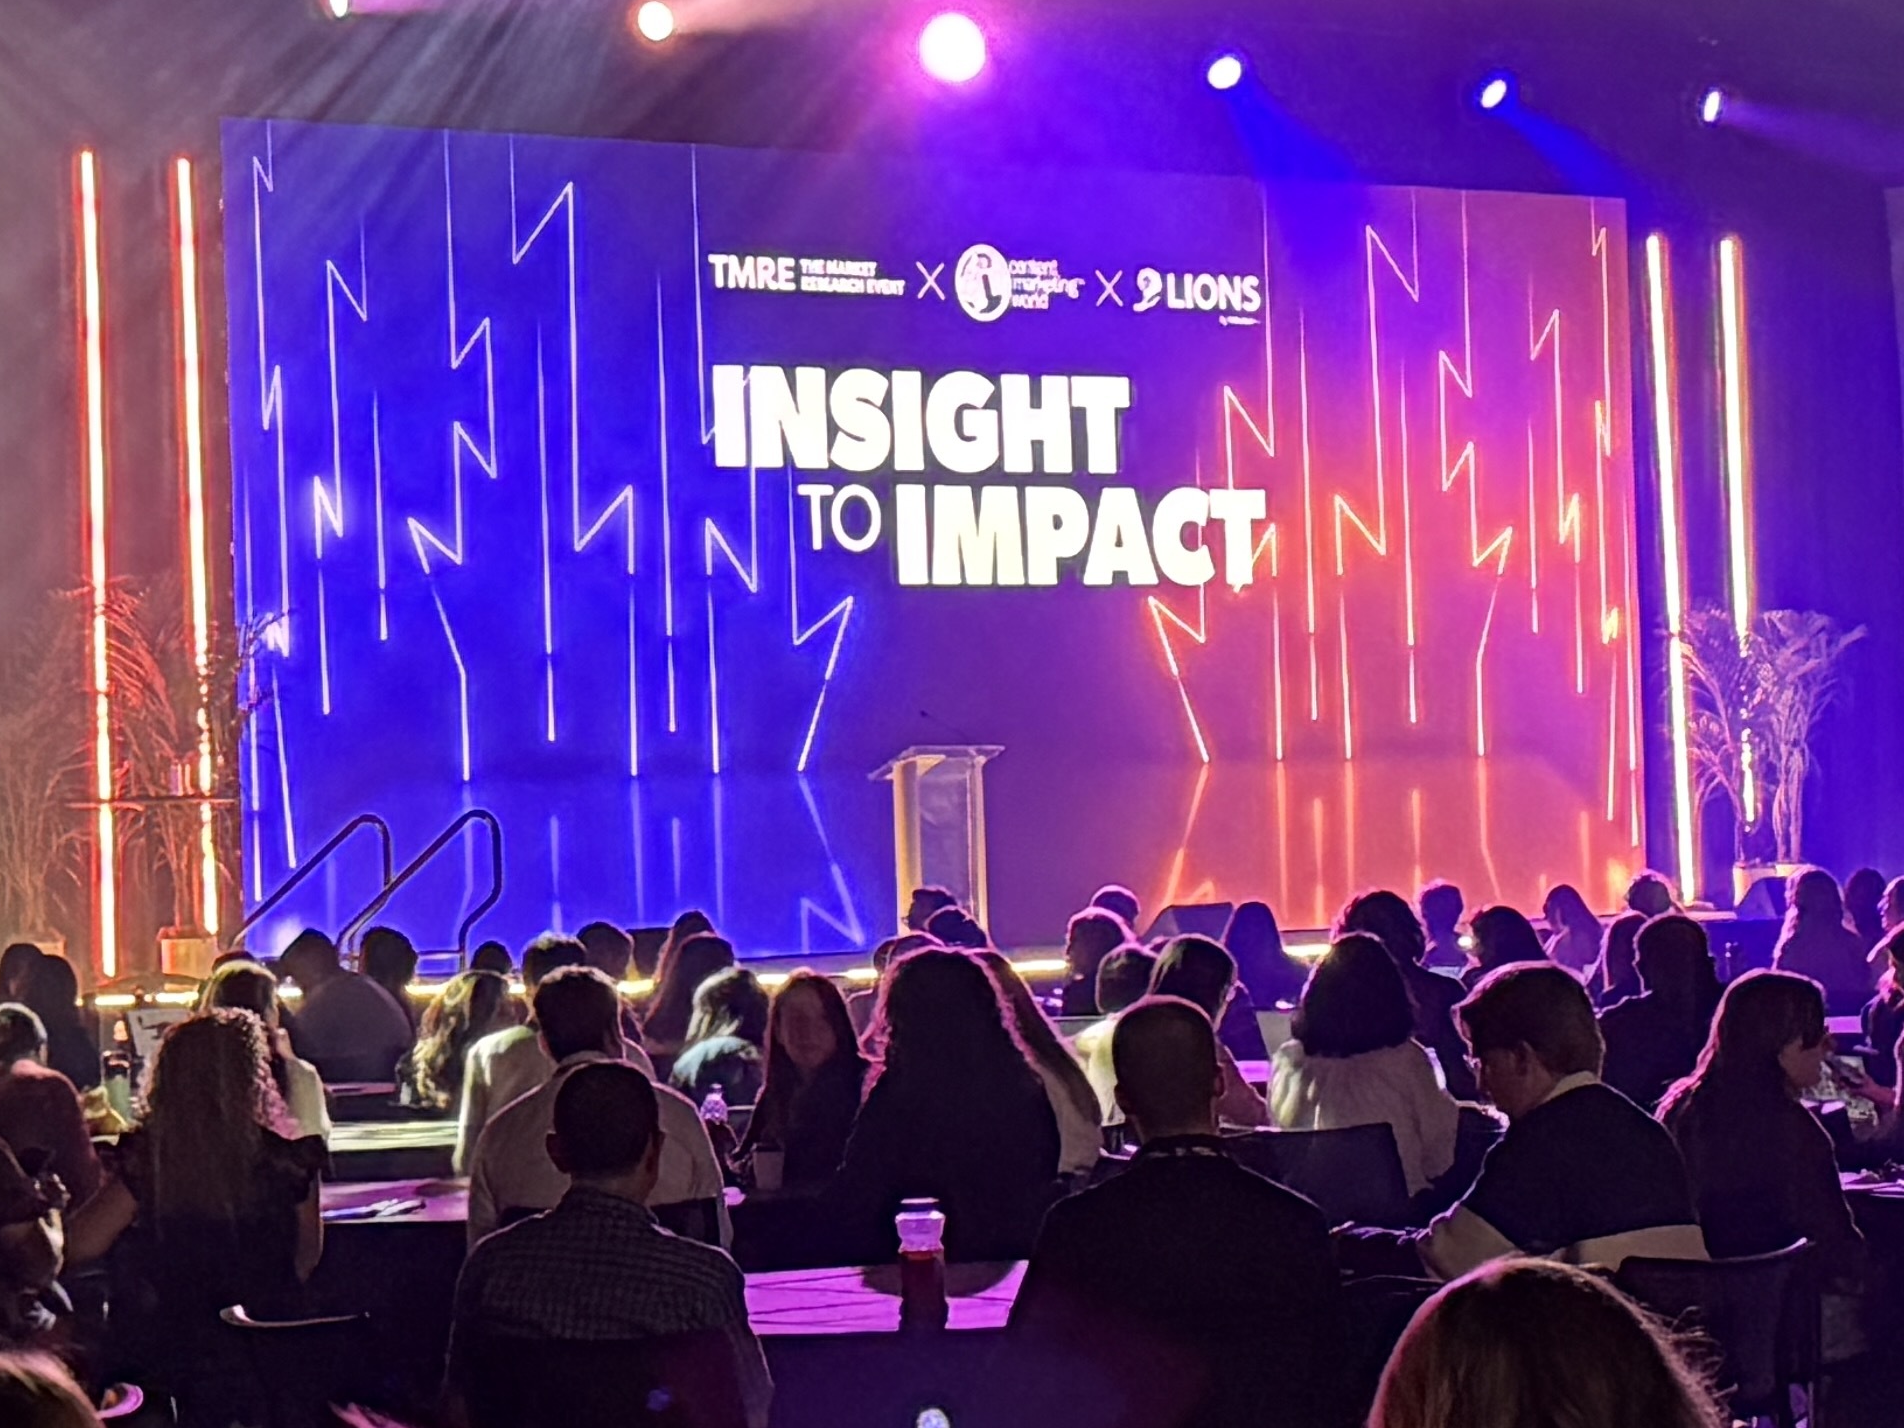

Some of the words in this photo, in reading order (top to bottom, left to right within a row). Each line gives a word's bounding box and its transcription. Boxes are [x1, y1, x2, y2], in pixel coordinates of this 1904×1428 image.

[707, 253, 796, 291] TMRE
[1166, 272, 1261, 312] LIONS
[711, 364, 1131, 474] INSIGHT
[797, 483, 882, 553] TO
[896, 482, 1266, 586] IMPACT
